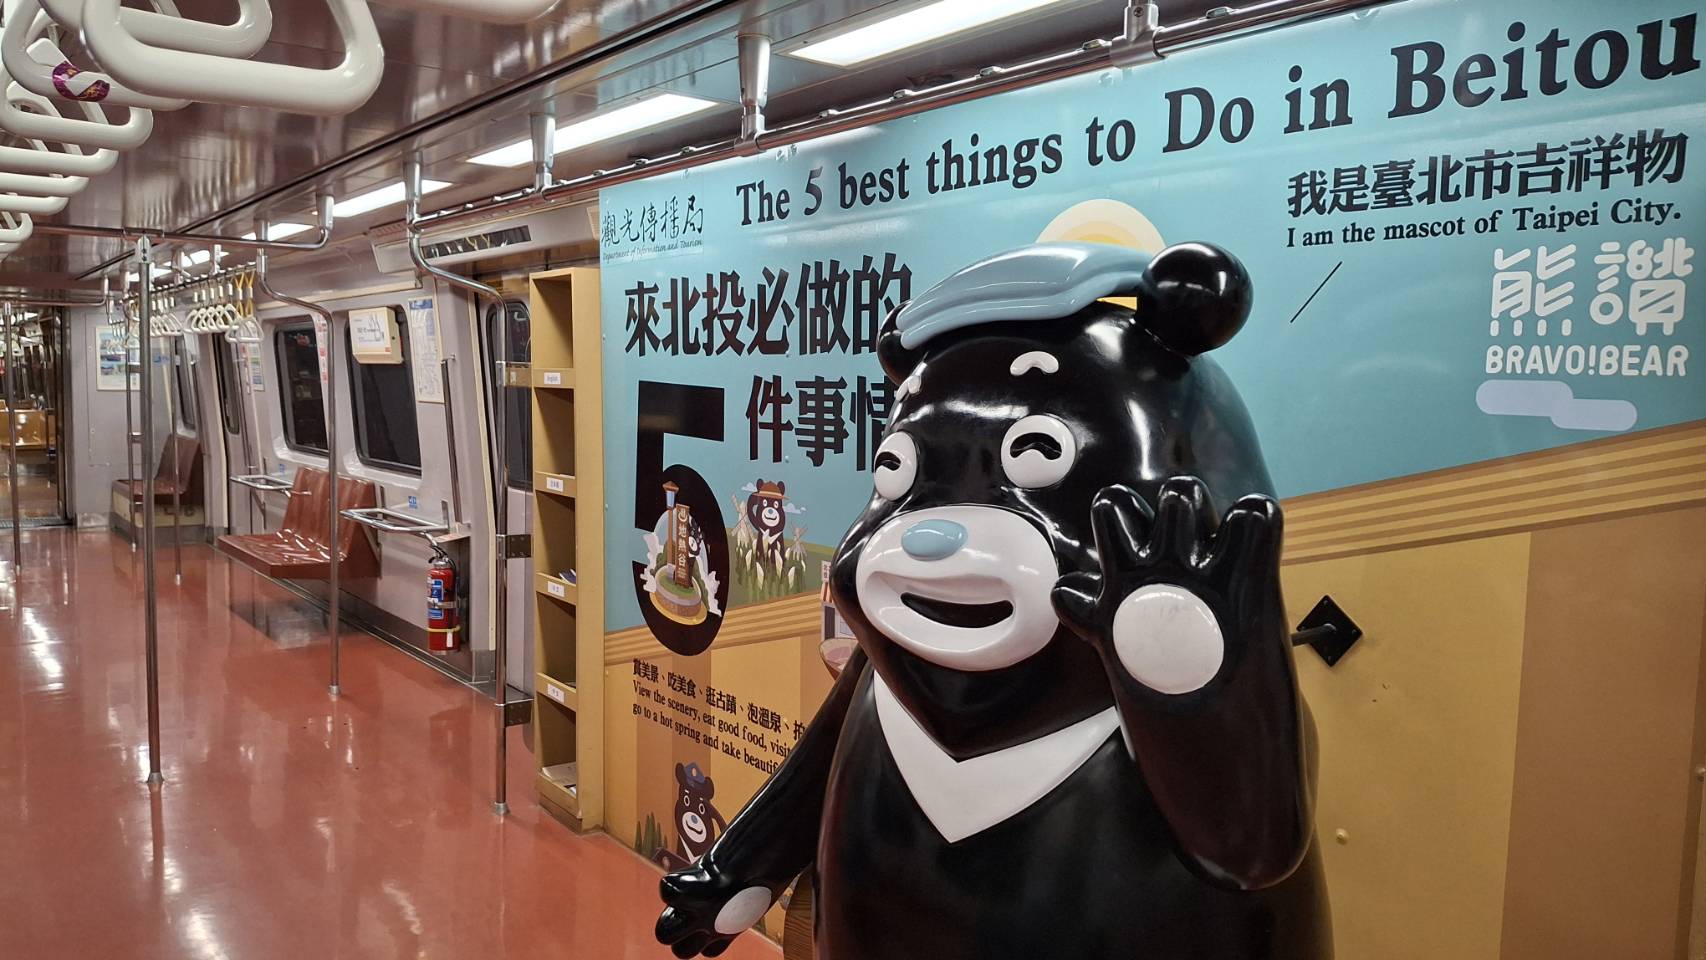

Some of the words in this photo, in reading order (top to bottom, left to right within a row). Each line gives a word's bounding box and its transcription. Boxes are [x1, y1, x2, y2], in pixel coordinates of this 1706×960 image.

[736, 179, 790, 226] The
[803, 165, 823, 215] 5
[838, 157, 910, 209] best
[925, 132, 1063, 189] things
[1086, 116, 1136, 166] to
[1162, 86, 1255, 153] Do
[1283, 64, 1353, 134] in
[1388, 12, 1702, 119] Beitou
[1287, 128, 1689, 218] 我是臺北市吉祥物
[602, 195, 703, 248] 觀光傳播局
[1286, 228, 1296, 247] I
[1302, 230, 1333, 246] am
[1342, 222, 1376, 242] the
[1383, 218, 1466, 240] mascot
[1474, 209, 1503, 233] of
[1512, 202, 1599, 232] Taipei
[1610, 198, 1682, 225] City.
[624, 252, 912, 358] 來北投必做的
[1485, 344, 1689, 377] BRAVO!BEAR
[632, 380, 730, 656] 5
[632, 703, 642, 715] go
[643, 706, 652, 719] to
[653, 711, 658, 722] a
[660, 711, 673, 728] hot
[674, 721, 701, 743] spring
[702, 734, 719, 749] and
[721, 740, 741, 760] take
[633, 680, 652, 698] View
[653, 689, 666, 705] the
[667, 698, 701, 722] scenery,
[702, 712, 716, 727] eat
[718, 719, 739, 737] good
[742, 726, 767, 752] food,
